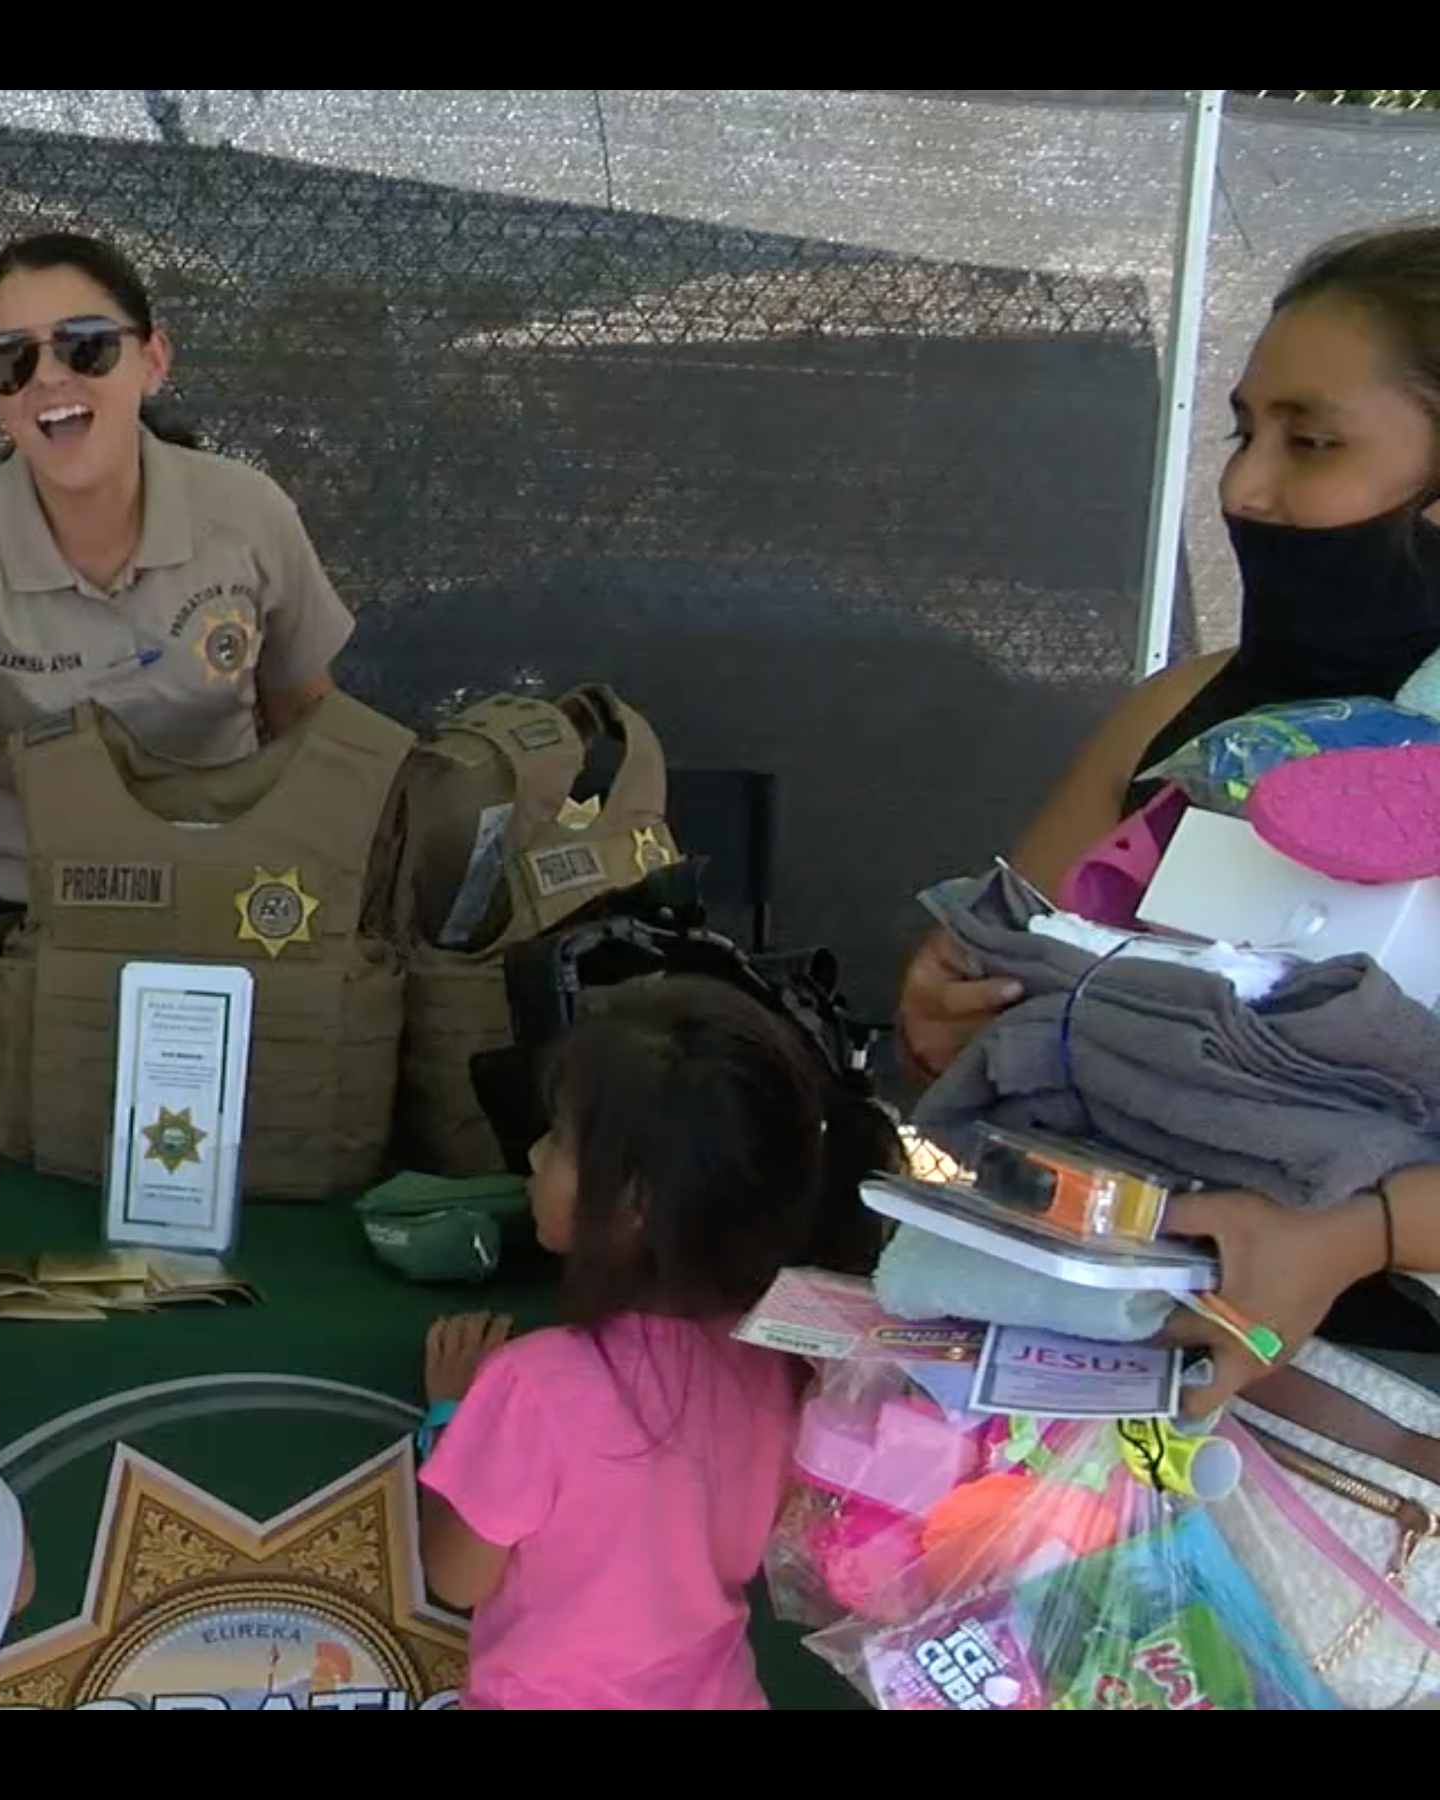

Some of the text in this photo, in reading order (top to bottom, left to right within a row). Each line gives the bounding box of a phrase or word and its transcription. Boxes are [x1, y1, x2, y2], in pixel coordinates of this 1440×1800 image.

[62, 866, 163, 903] PROBATION
[201, 1623, 303, 1646] EUREKA
[943, 1630, 996, 1684] ICE
